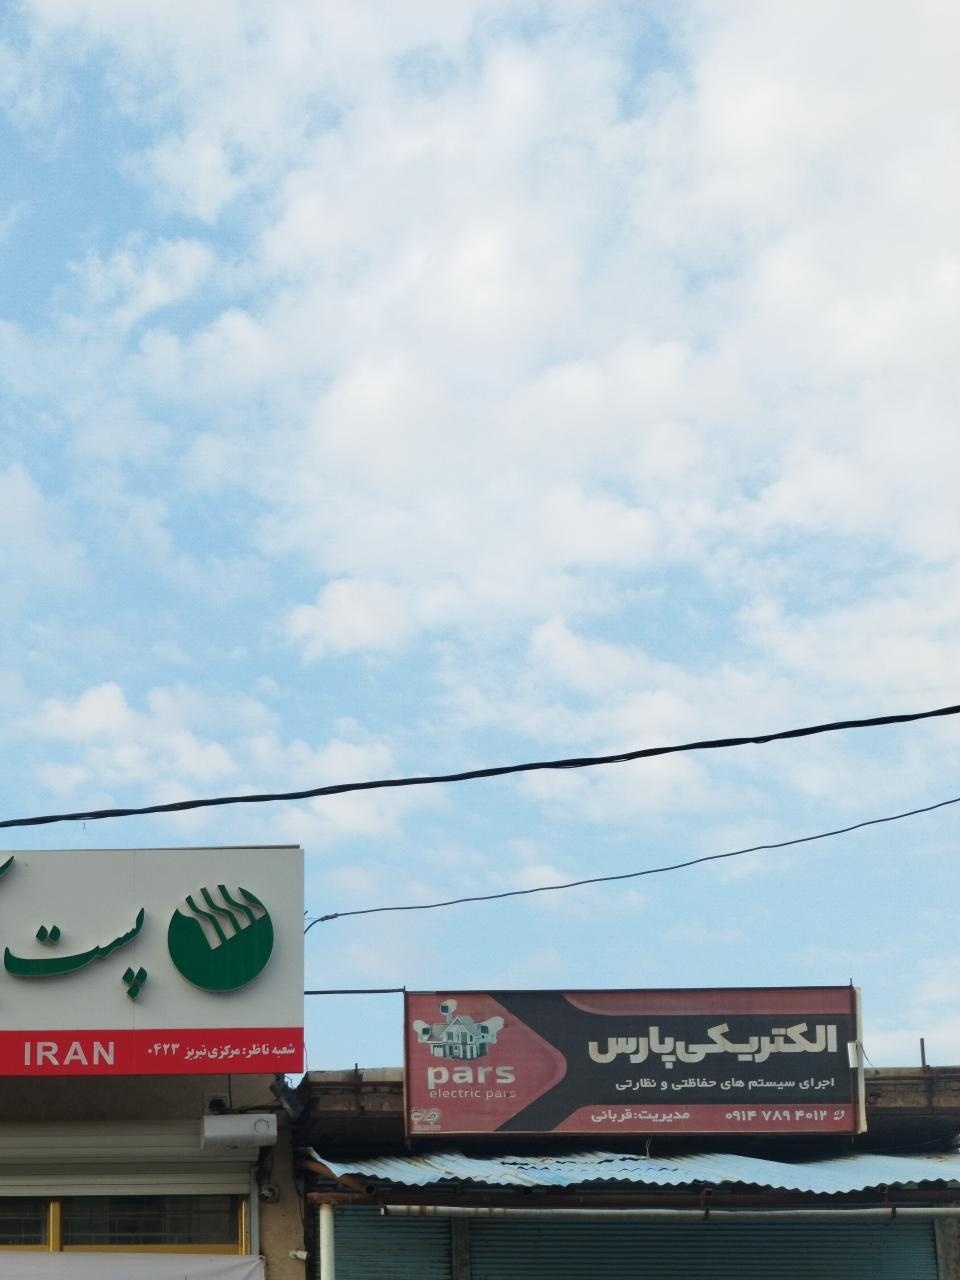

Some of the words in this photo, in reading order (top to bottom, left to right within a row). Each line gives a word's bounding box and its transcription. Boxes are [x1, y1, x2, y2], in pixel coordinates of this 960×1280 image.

[4, 907, 148, 1001] پست
[271, 1043, 296, 1059] شعبه
[588, 1026, 677, 1070] پارس
[676, 1023, 838, 1064] الکتریکی
[23, 1041, 116, 1066] IRAN
[183, 1044, 208, 1061] تبریز
[207, 1044, 241, 1060] مرکزی
[426, 1065, 517, 1090] pars
[614, 1076, 658, 1092] نظارتی
[670, 1076, 718, 1091] حفاظتی
[719, 1077, 745, 1091] های
[747, 1077, 796, 1091] سیستم
[797, 1076, 836, 1091] اجرای
[429, 1088, 481, 1099] electric
[660, 1080, 669, 1092] و
[761, 1109, 791, 1121] ۷۸۹
